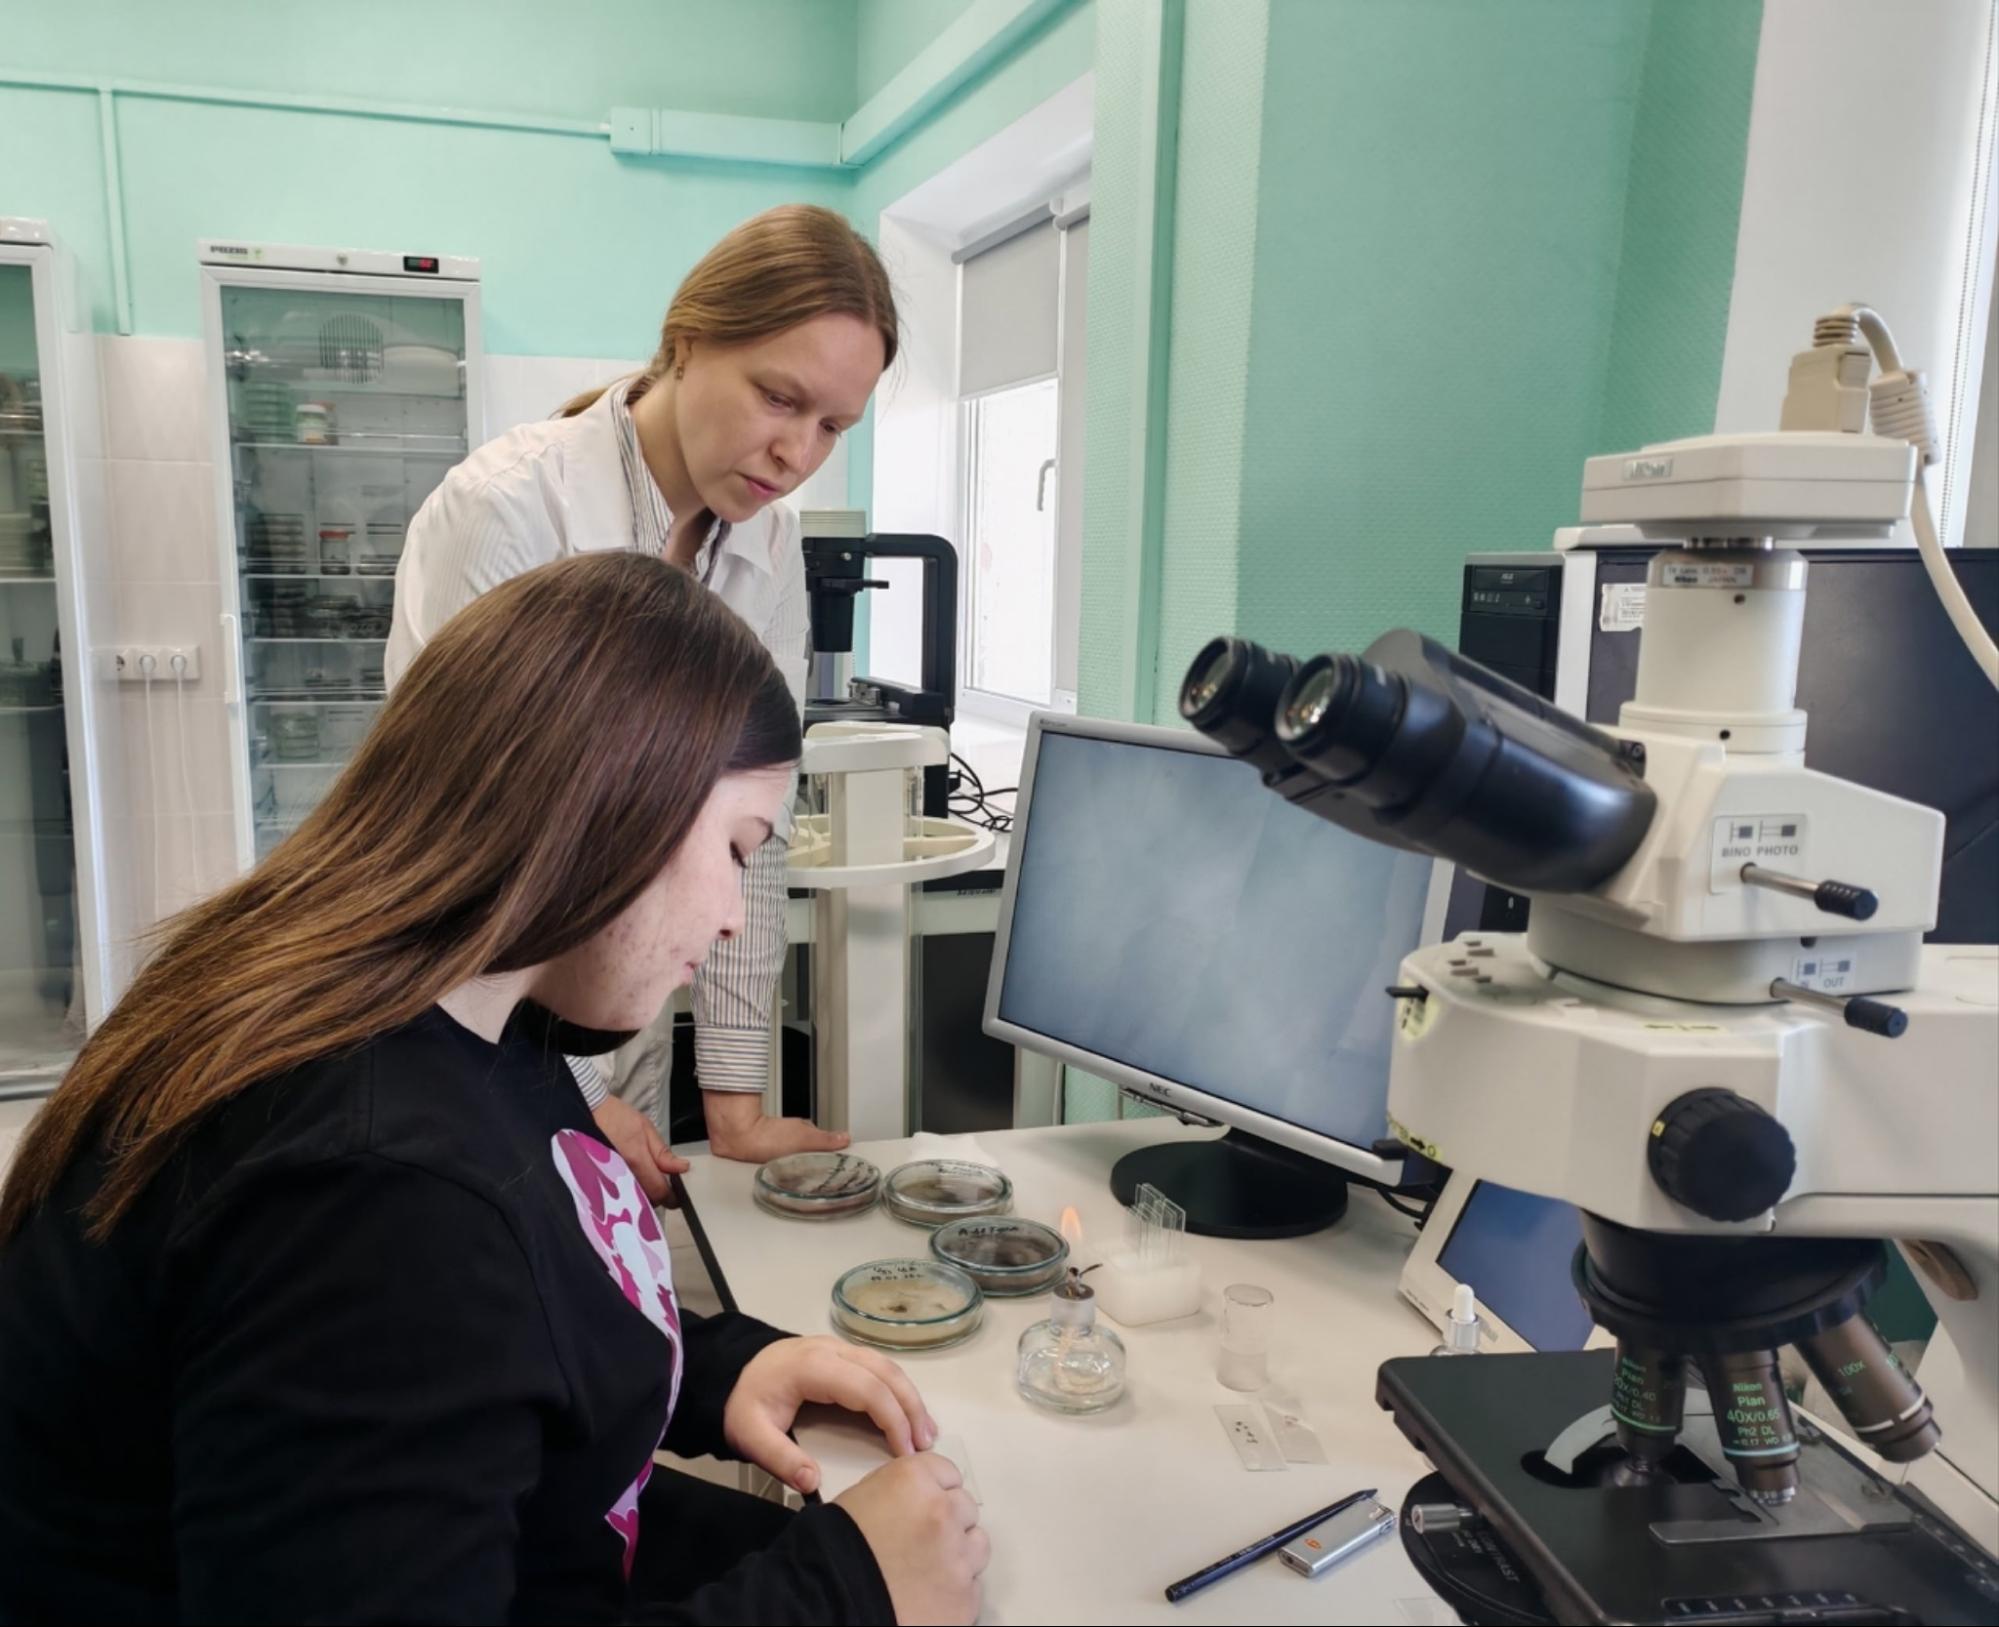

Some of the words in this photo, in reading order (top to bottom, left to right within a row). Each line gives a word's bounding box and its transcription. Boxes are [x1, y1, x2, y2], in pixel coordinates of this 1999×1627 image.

[1721, 846, 1752, 858] BINO
[1756, 844, 1799, 857] PHOTO
[1823, 976, 1844, 988] OUT
[1150, 1083, 1172, 1097] NEC
[1737, 1396, 1766, 1407] Plan
